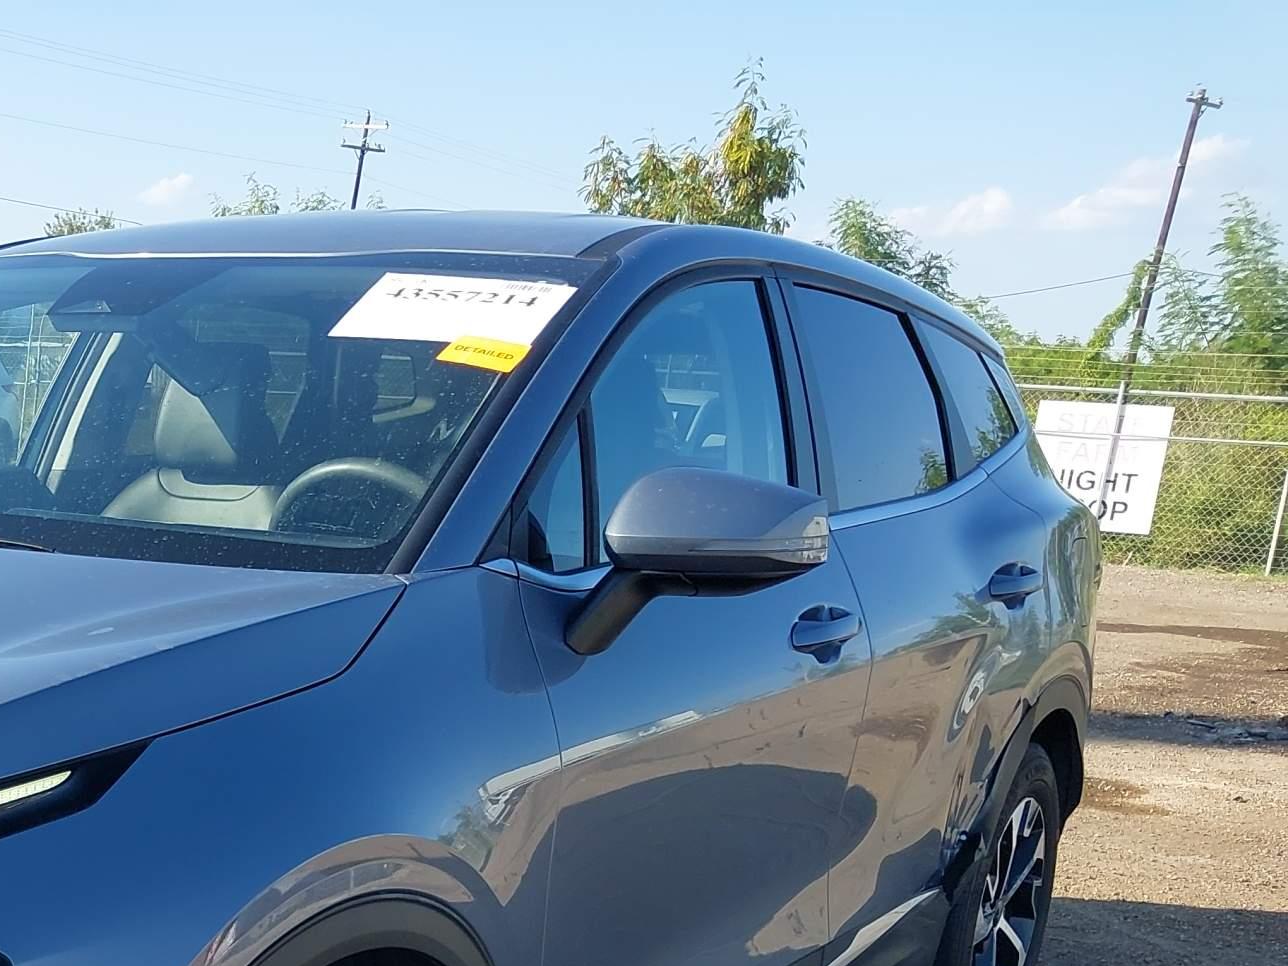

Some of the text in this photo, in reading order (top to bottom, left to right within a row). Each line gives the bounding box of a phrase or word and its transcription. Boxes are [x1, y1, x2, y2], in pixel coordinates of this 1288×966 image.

[386, 287, 539, 308] 43557214
[454, 344, 515, 361] DETAILED
[1057, 412, 1144, 434] STAE
[1060, 469, 1139, 494] IGHT
